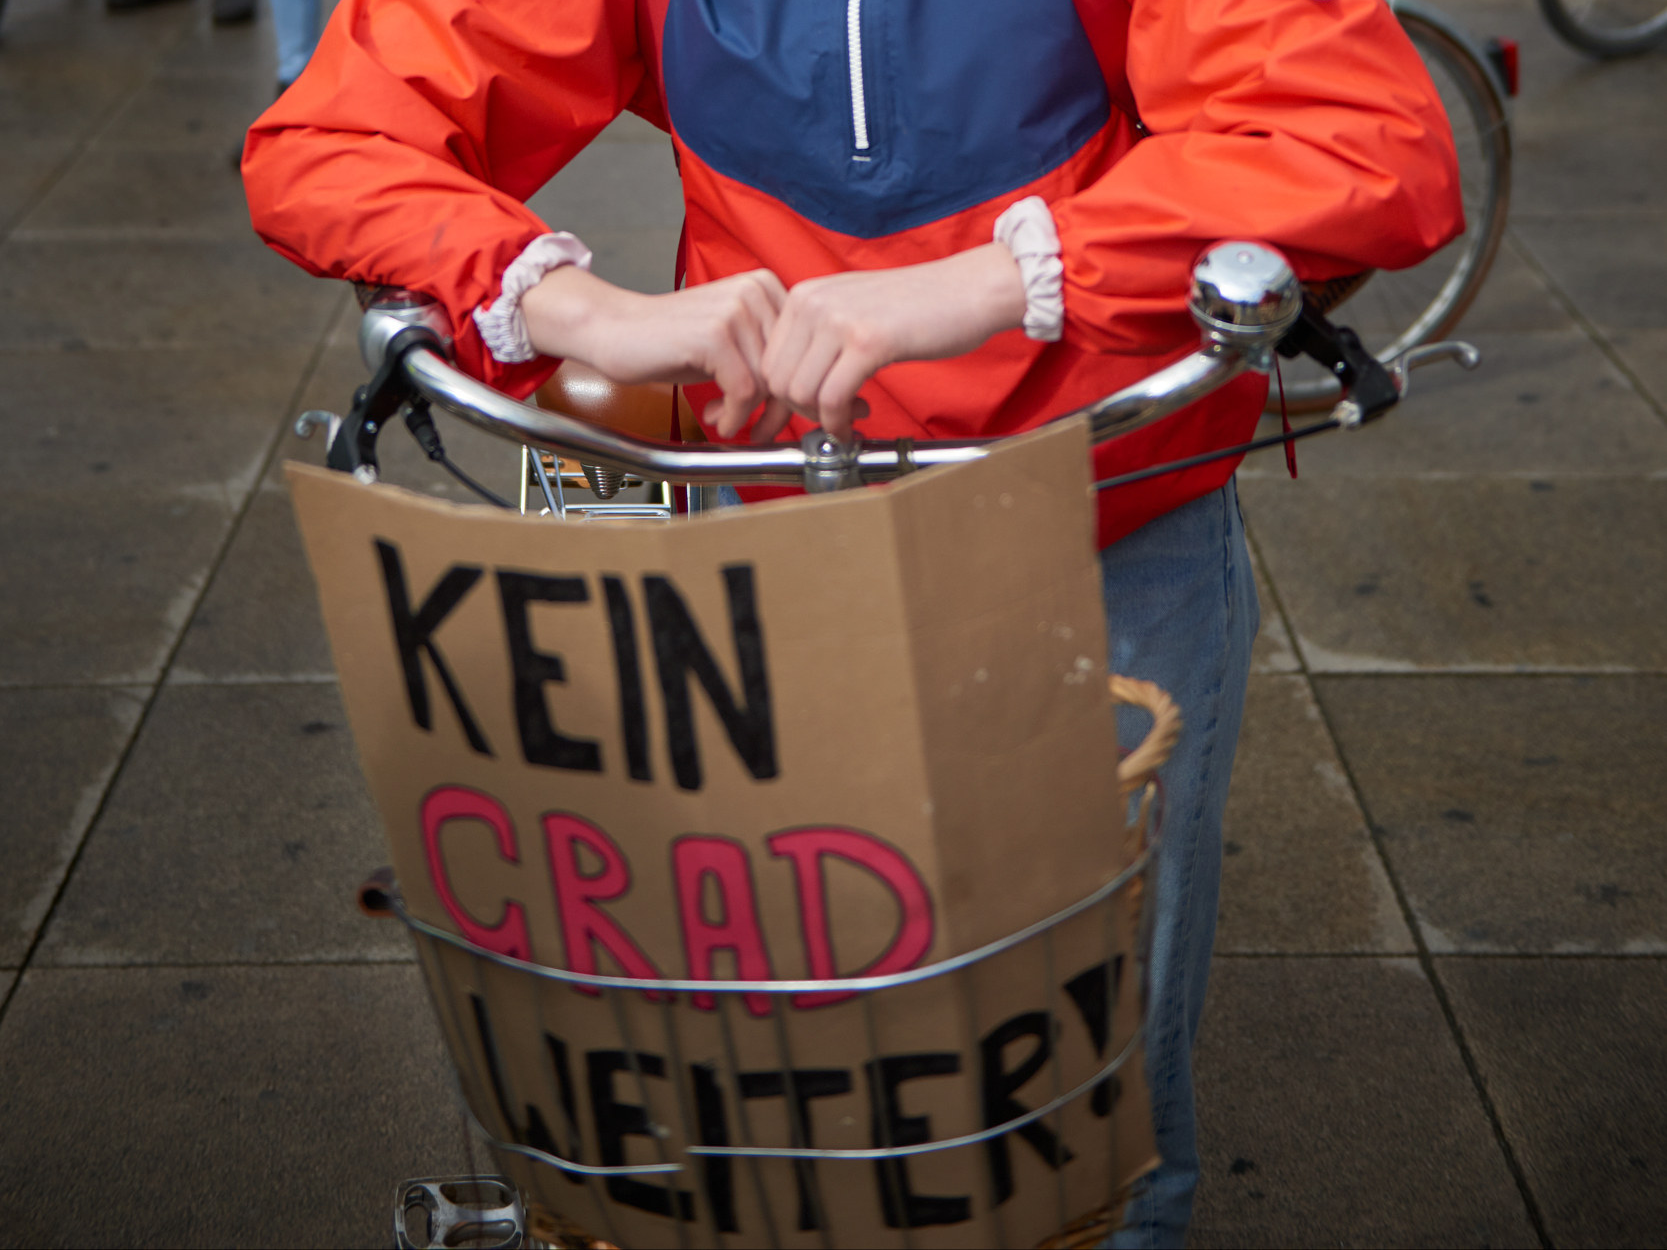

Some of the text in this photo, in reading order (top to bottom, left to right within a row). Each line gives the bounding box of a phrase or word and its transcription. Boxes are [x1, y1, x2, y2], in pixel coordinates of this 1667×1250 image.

[373, 535, 779, 792] KEIN
[420, 784, 937, 1018] GRAD
[469, 953, 1125, 1234] WEITER!
